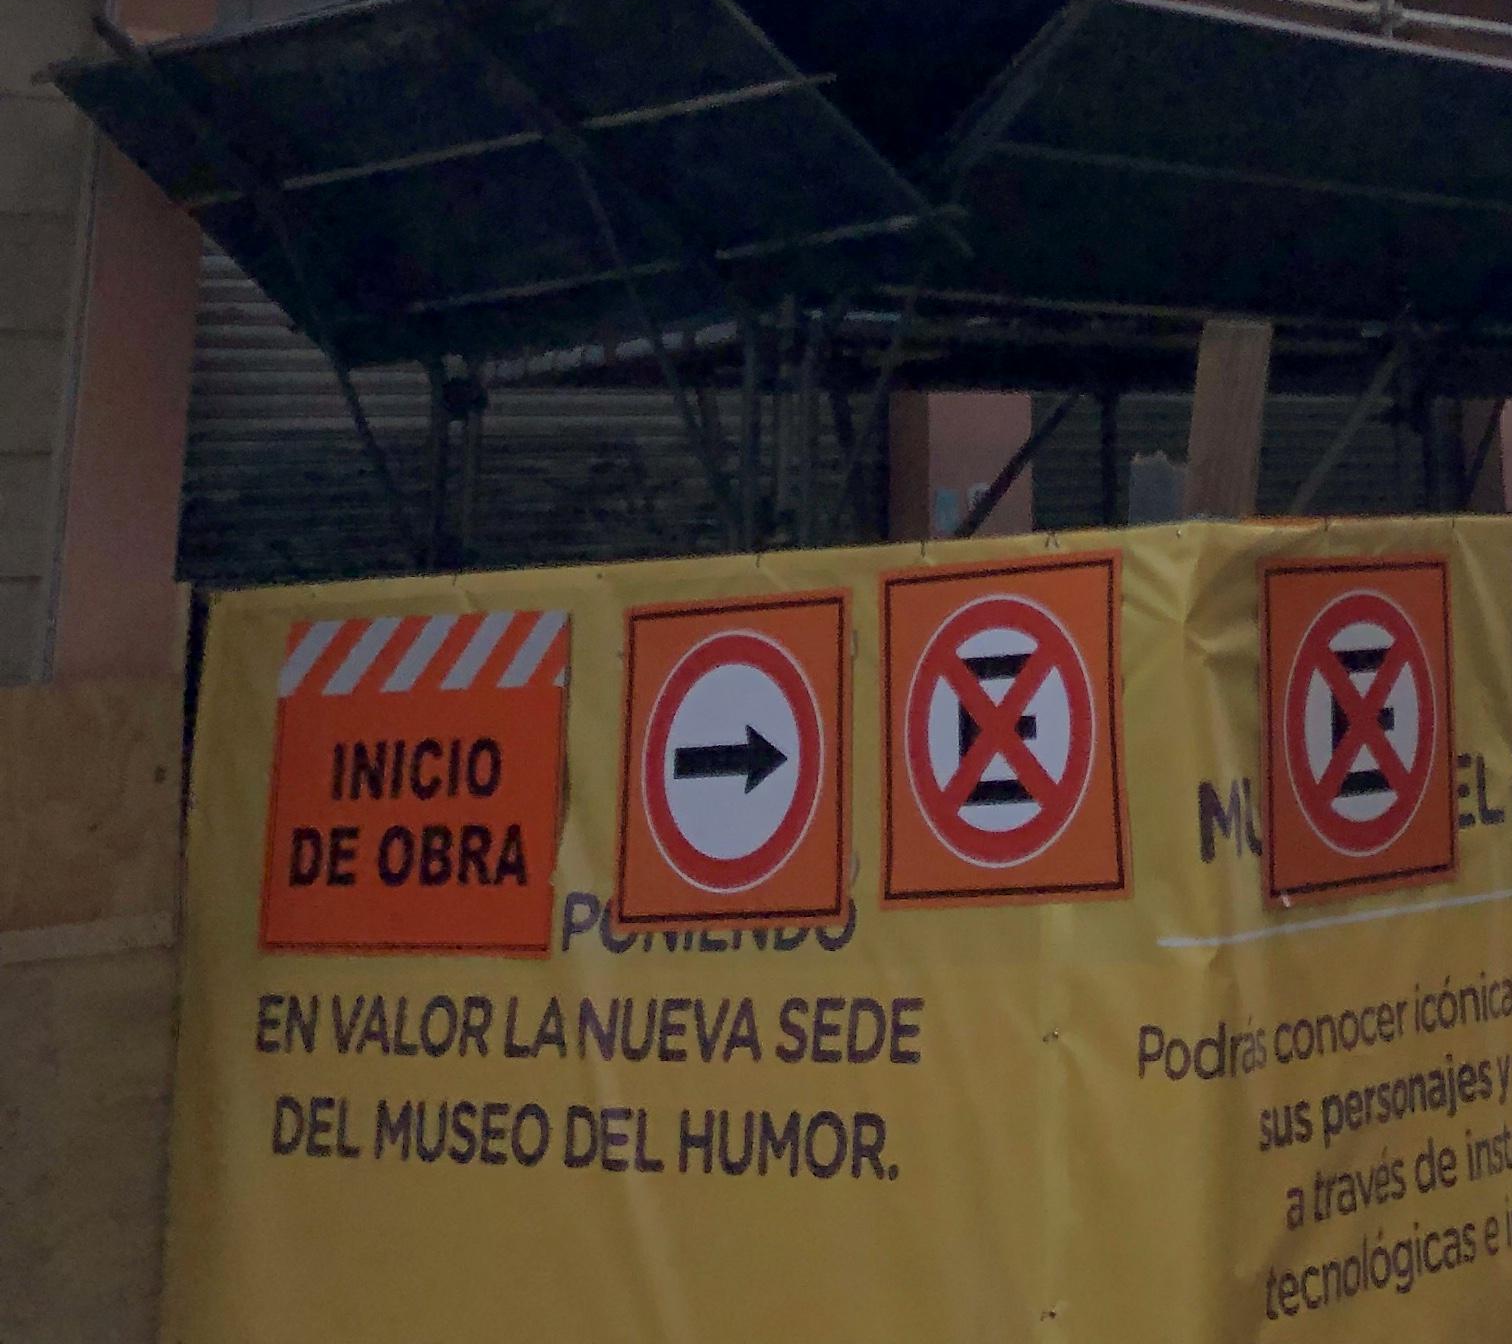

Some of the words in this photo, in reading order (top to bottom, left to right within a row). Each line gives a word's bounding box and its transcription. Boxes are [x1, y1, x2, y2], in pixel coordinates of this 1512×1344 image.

[332, 736, 503, 801] INICIO
[289, 825, 360, 888] DE
[378, 823, 528, 888] OBRA
[256, 992, 320, 1055] EN
[331, 993, 493, 1058] VALOR
[503, 995, 567, 1059] LA
[578, 995, 762, 1063] NUEVA
[775, 995, 926, 1064] SEDE
[1138, 1015, 1267, 1081] Podrás
[1273, 1000, 1407, 1064] conocer
[272, 1095, 361, 1159] DEL
[374, 1098, 550, 1167] MUSEO
[564, 1104, 665, 1173] DEL
[678, 1108, 900, 1181] HUMOR.
[1258, 1099, 1314, 1152] sus
[1321, 1054, 1494, 1150] personajes
[1496, 1054, 1511, 1105] y
[1285, 1185, 1305, 1231] a
[1312, 1144, 1407, 1223] través
[1414, 1136, 1458, 1194] de
[1264, 1220, 1476, 1321] tecnológicas
[1484, 1215, 1500, 1257] e
